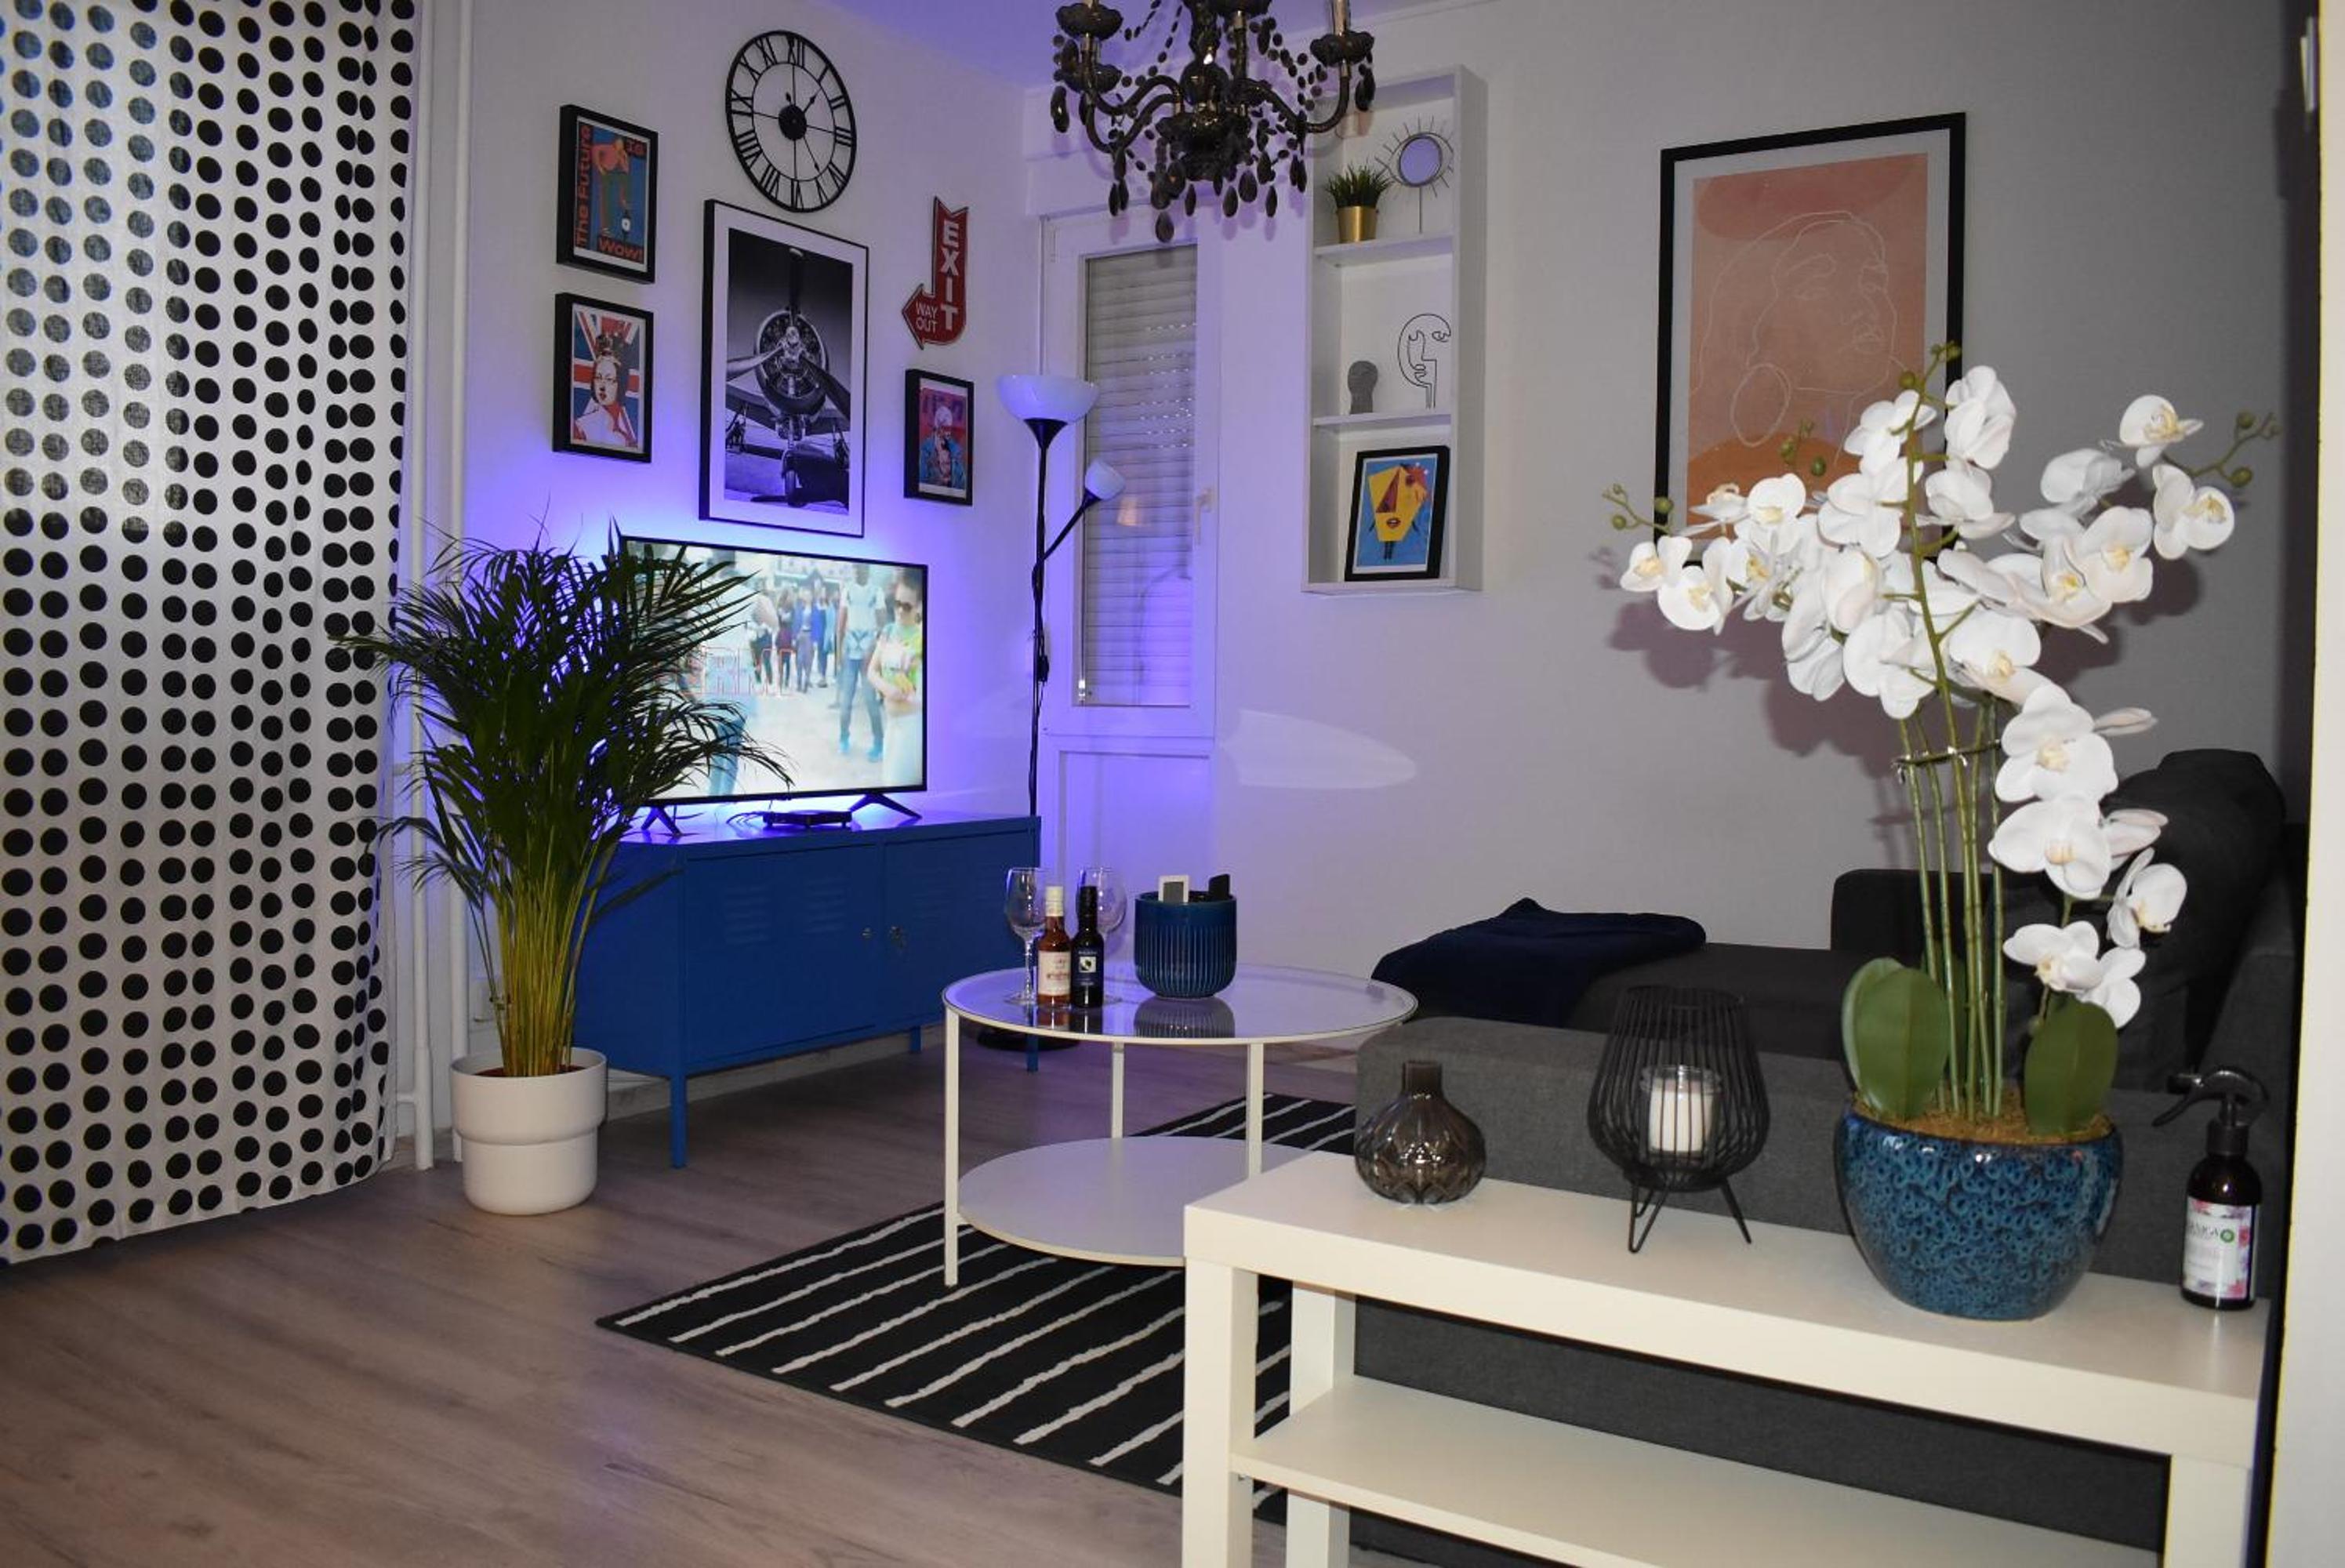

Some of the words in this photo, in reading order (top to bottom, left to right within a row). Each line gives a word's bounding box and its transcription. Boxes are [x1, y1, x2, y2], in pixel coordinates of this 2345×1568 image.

[579, 125, 592, 198] Future
[575, 205, 590, 247] The
[941, 220, 960, 332] EXIT
[915, 301, 938, 318] WAY
[915, 318, 938, 333] OUT
